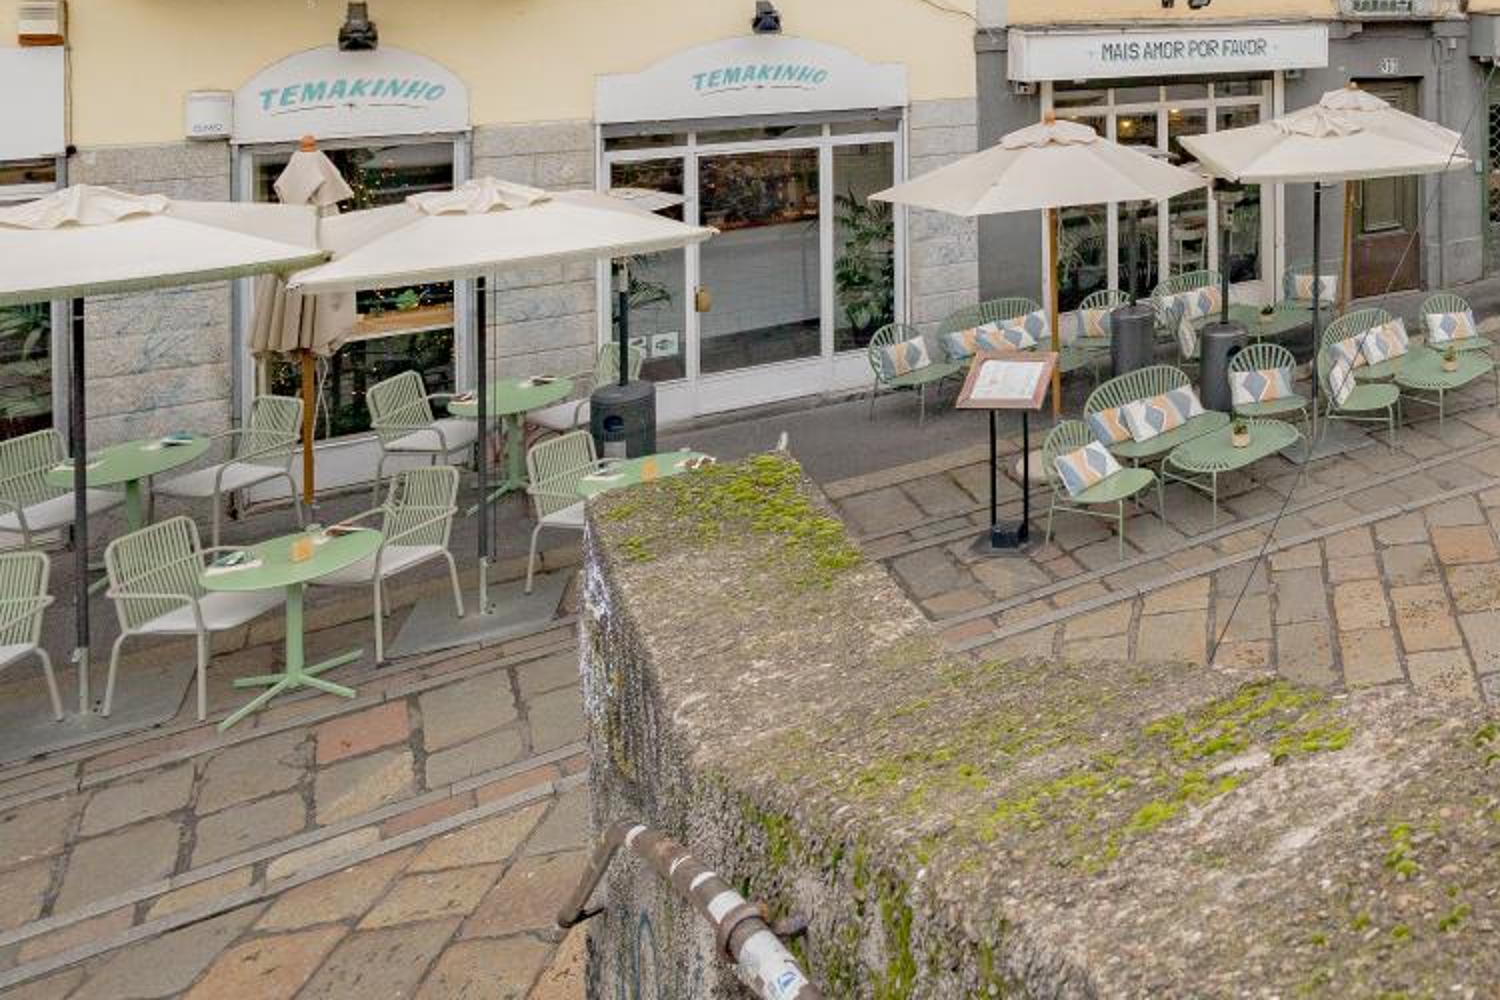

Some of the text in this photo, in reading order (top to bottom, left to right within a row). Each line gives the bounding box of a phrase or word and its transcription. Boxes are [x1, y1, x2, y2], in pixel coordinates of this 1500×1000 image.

[1101, 37, 1267, 61] MAIS AMOR POR FAVOR
[692, 64, 829, 90] TEMAKINHO
[259, 78, 446, 110] TEMAKINHO
